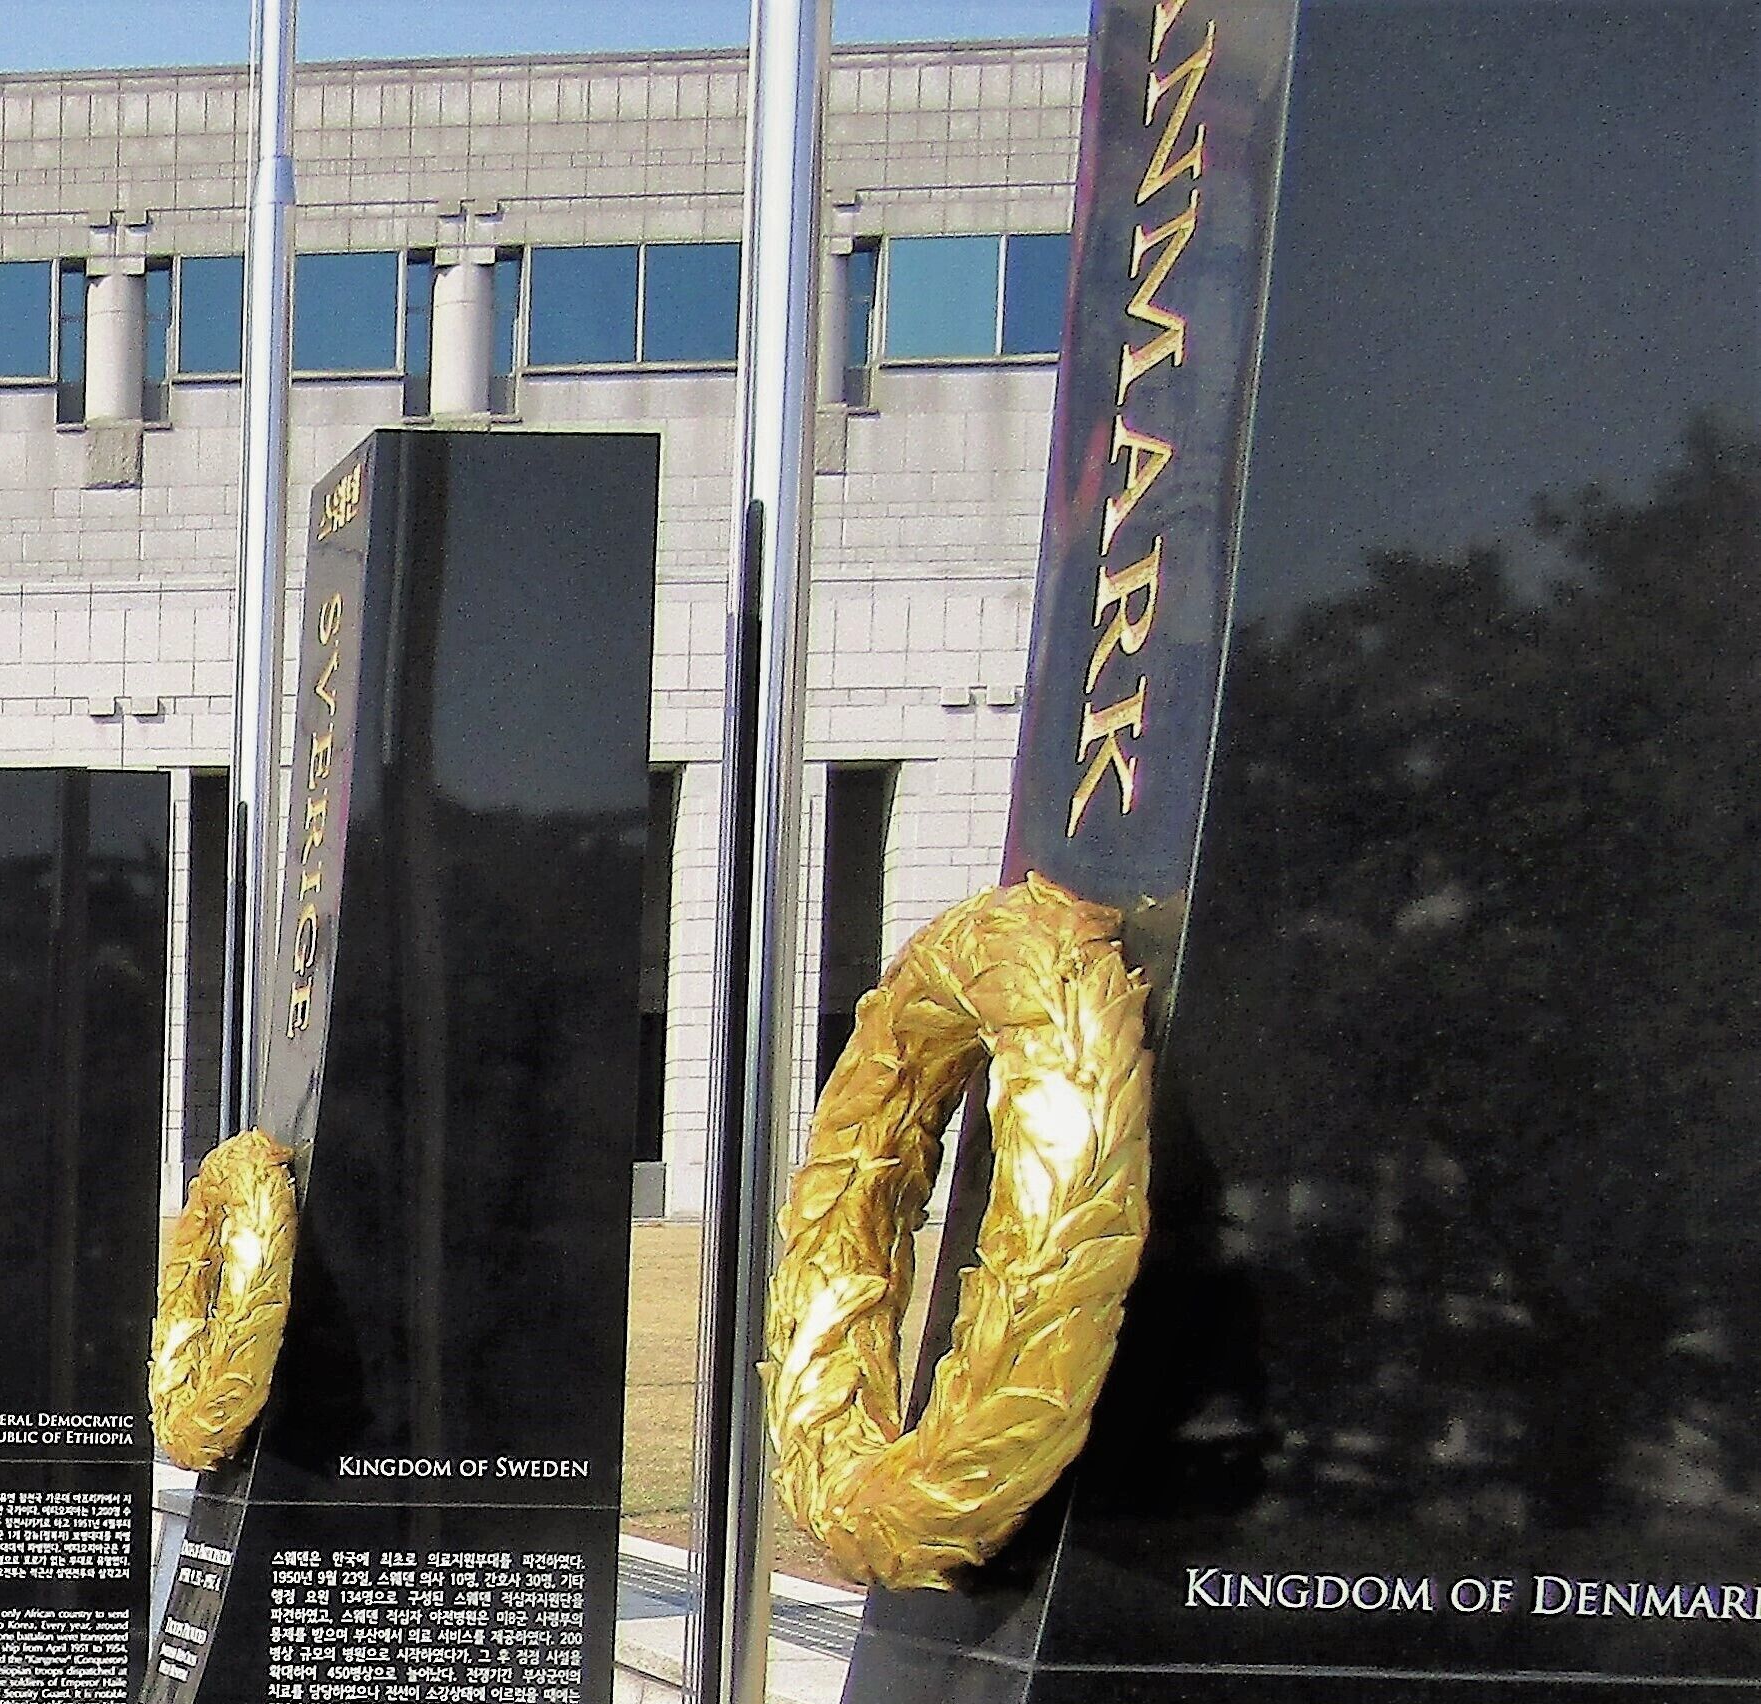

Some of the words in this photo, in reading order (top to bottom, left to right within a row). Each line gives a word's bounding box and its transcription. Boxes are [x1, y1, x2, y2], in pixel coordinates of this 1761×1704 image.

[38, 1413, 134, 1428] DEMOCRATIC
[41, 1431, 61, 1443] OF
[66, 1430, 134, 1445] ETHIOPIA
[339, 1456, 452, 1477] KINGDOM
[459, 1459, 488, 1477] OF
[495, 1456, 589, 1478] SWEDEN
[1184, 1568, 1433, 1611] KINGDOM
[1450, 1578, 1513, 1613] OF
[1531, 1575, 1761, 1620] DENMAR
[1, 1608, 21, 1620] only
[24, 1608, 56, 1618] African
[58, 1611, 93, 1620] country
[95, 1610, 104, 1618] to
[108, 1609, 129, 1618] send
